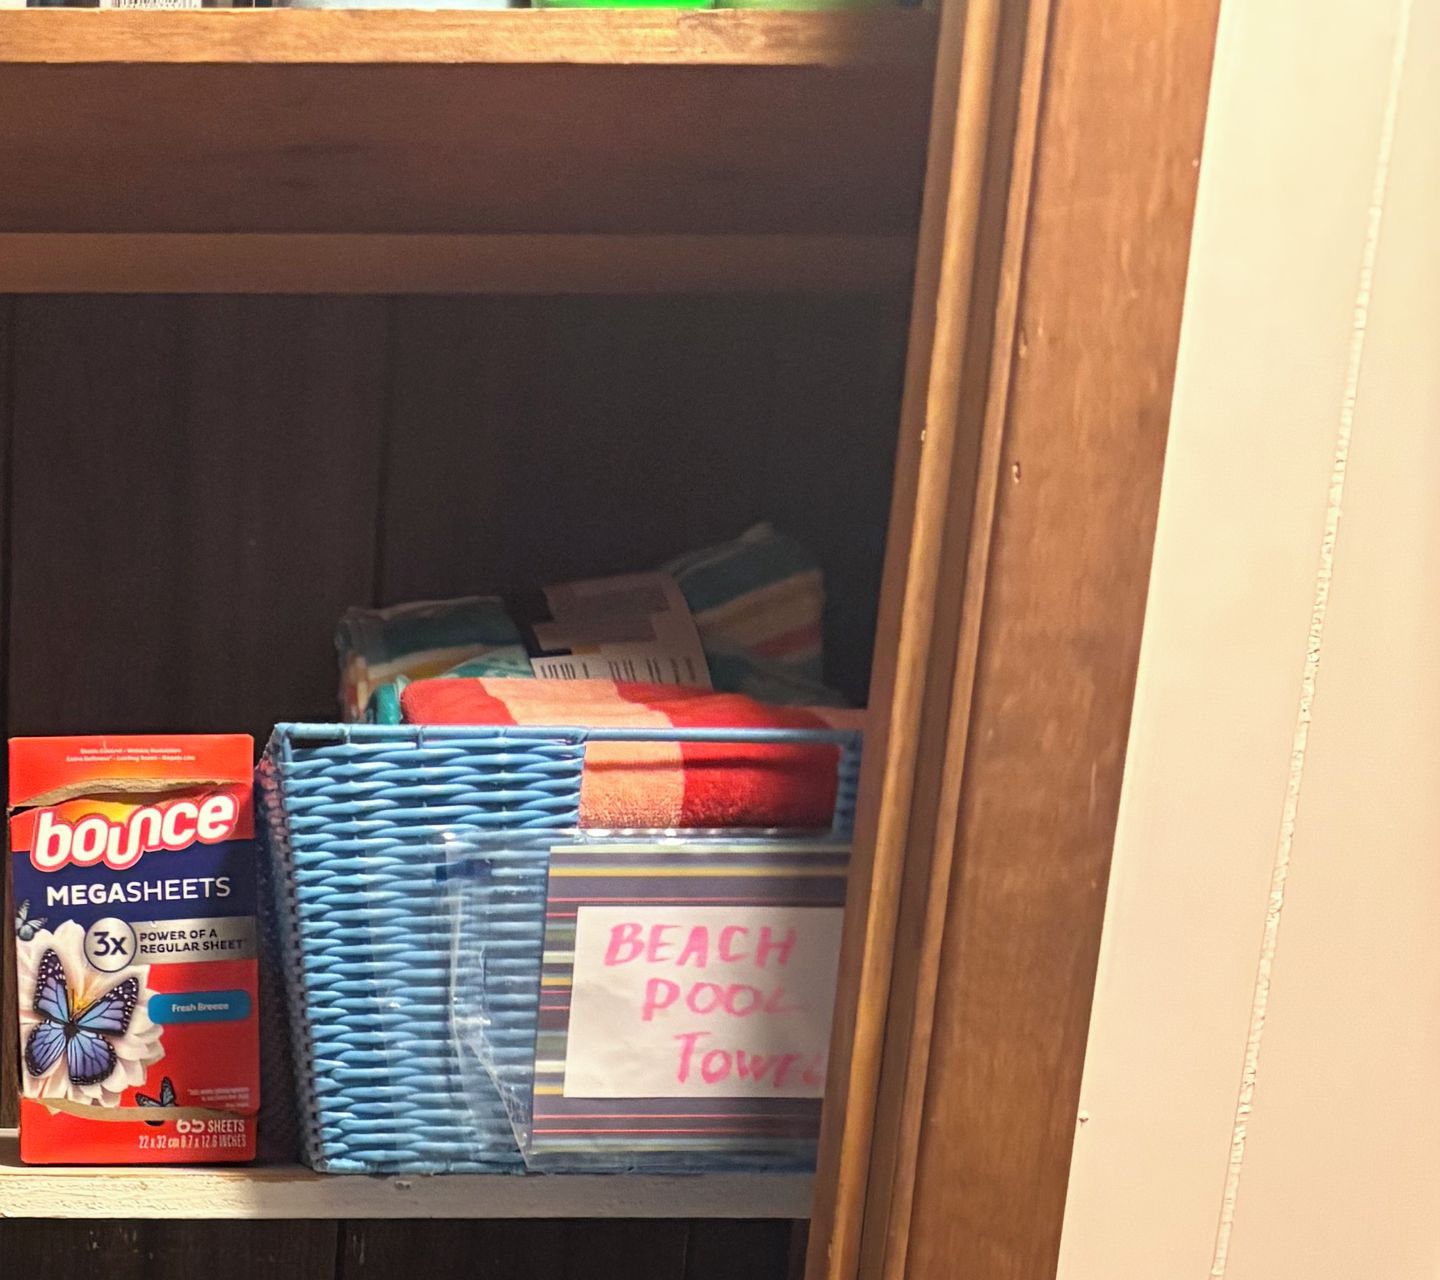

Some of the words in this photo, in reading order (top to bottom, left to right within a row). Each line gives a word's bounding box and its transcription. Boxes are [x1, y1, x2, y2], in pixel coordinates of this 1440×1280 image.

[34, 794, 236, 868] bounce
[46, 877, 231, 906] MEGASHEETS
[140, 930, 187, 942] POWER
[189, 930, 206, 940] OF
[209, 929, 217, 938] A
[93, 931, 128, 956] 3x
[140, 942, 203, 954] REGULAR
[203, 939, 244, 951] SHEET
[603, 922, 799, 969] BEACH
[172, 1003, 197, 1012] Fresh
[197, 1002, 230, 1012] Breeze
[207, 1119, 246, 1133] SHEETS
[139, 1135, 150, 1149] 22
[156, 1135, 167, 1149] 32
[219, 1134, 247, 1148] INCHES
